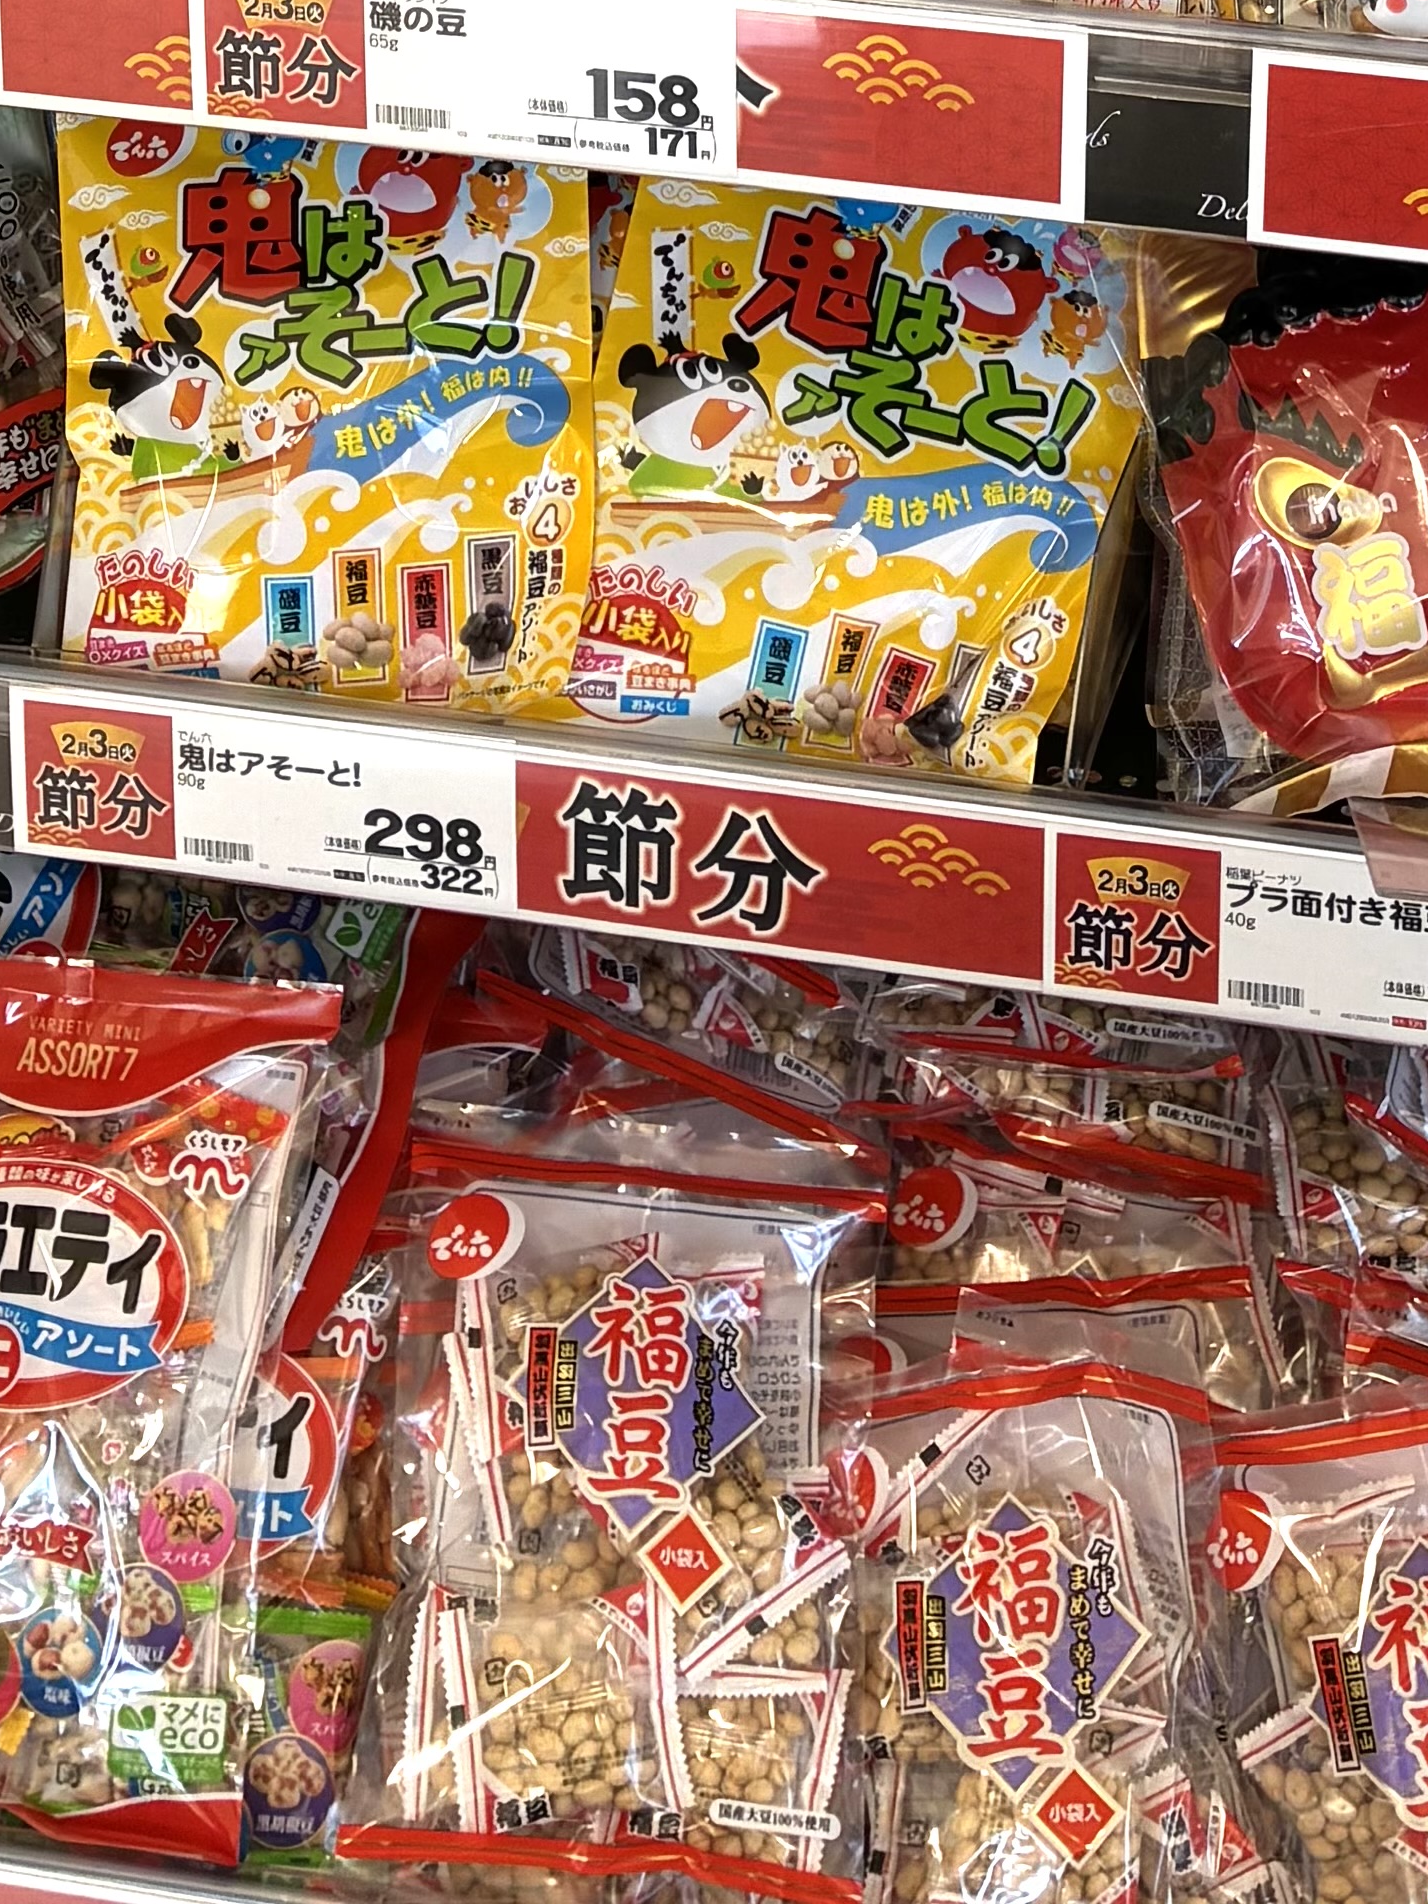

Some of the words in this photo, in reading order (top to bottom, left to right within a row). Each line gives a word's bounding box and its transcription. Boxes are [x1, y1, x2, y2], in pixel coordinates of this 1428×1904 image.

[369, 1, 467, 40] 磯の豆
[170, 169, 389, 312] 鬼は
[346, 559, 369, 605] 福豆
[629, 700, 679, 714] おみくじ
[177, 771, 206, 789] 90g
[1224, 910, 1257, 931] 40g
[16, 1039, 116, 1081] ASSORT
[32, 1318, 141, 1369] アソート
[658, 1543, 711, 1571] 小袋入
[158, 1726, 220, 1752] eco
